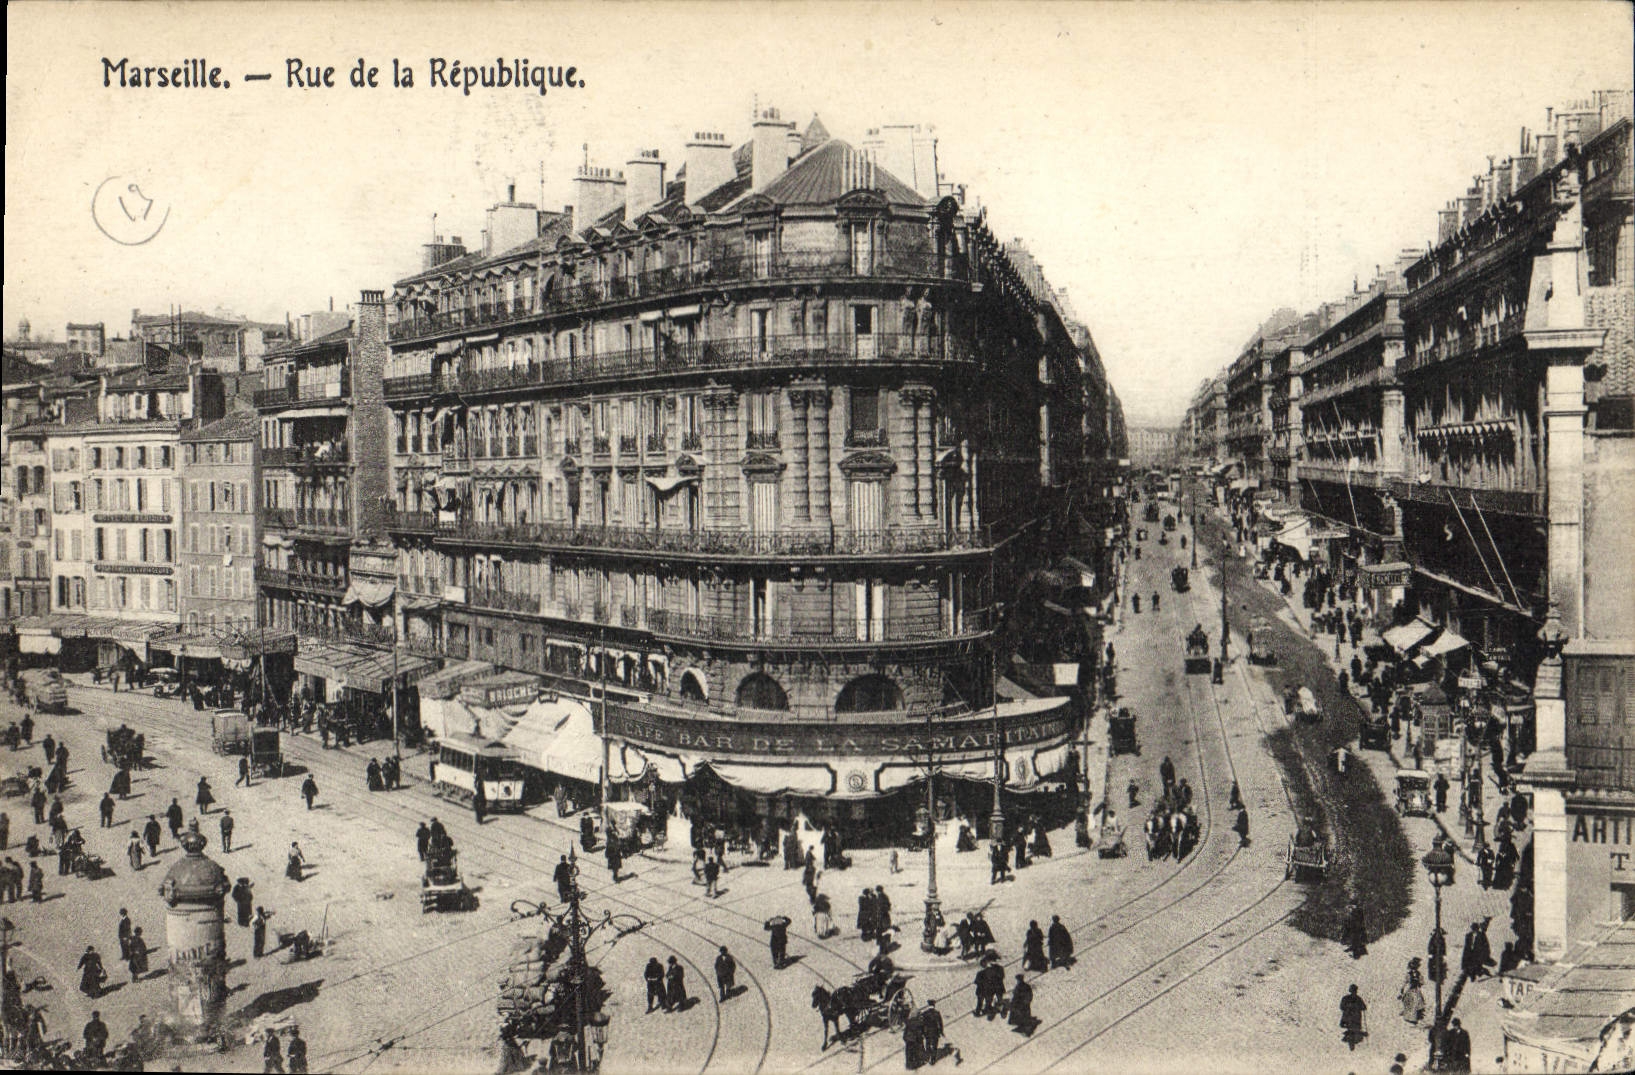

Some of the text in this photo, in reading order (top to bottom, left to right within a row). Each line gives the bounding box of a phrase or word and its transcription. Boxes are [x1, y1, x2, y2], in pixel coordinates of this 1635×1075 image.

[679, 733, 734, 749] BAR
[752, 737, 795, 751] DE
[816, 738, 864, 752] LA
